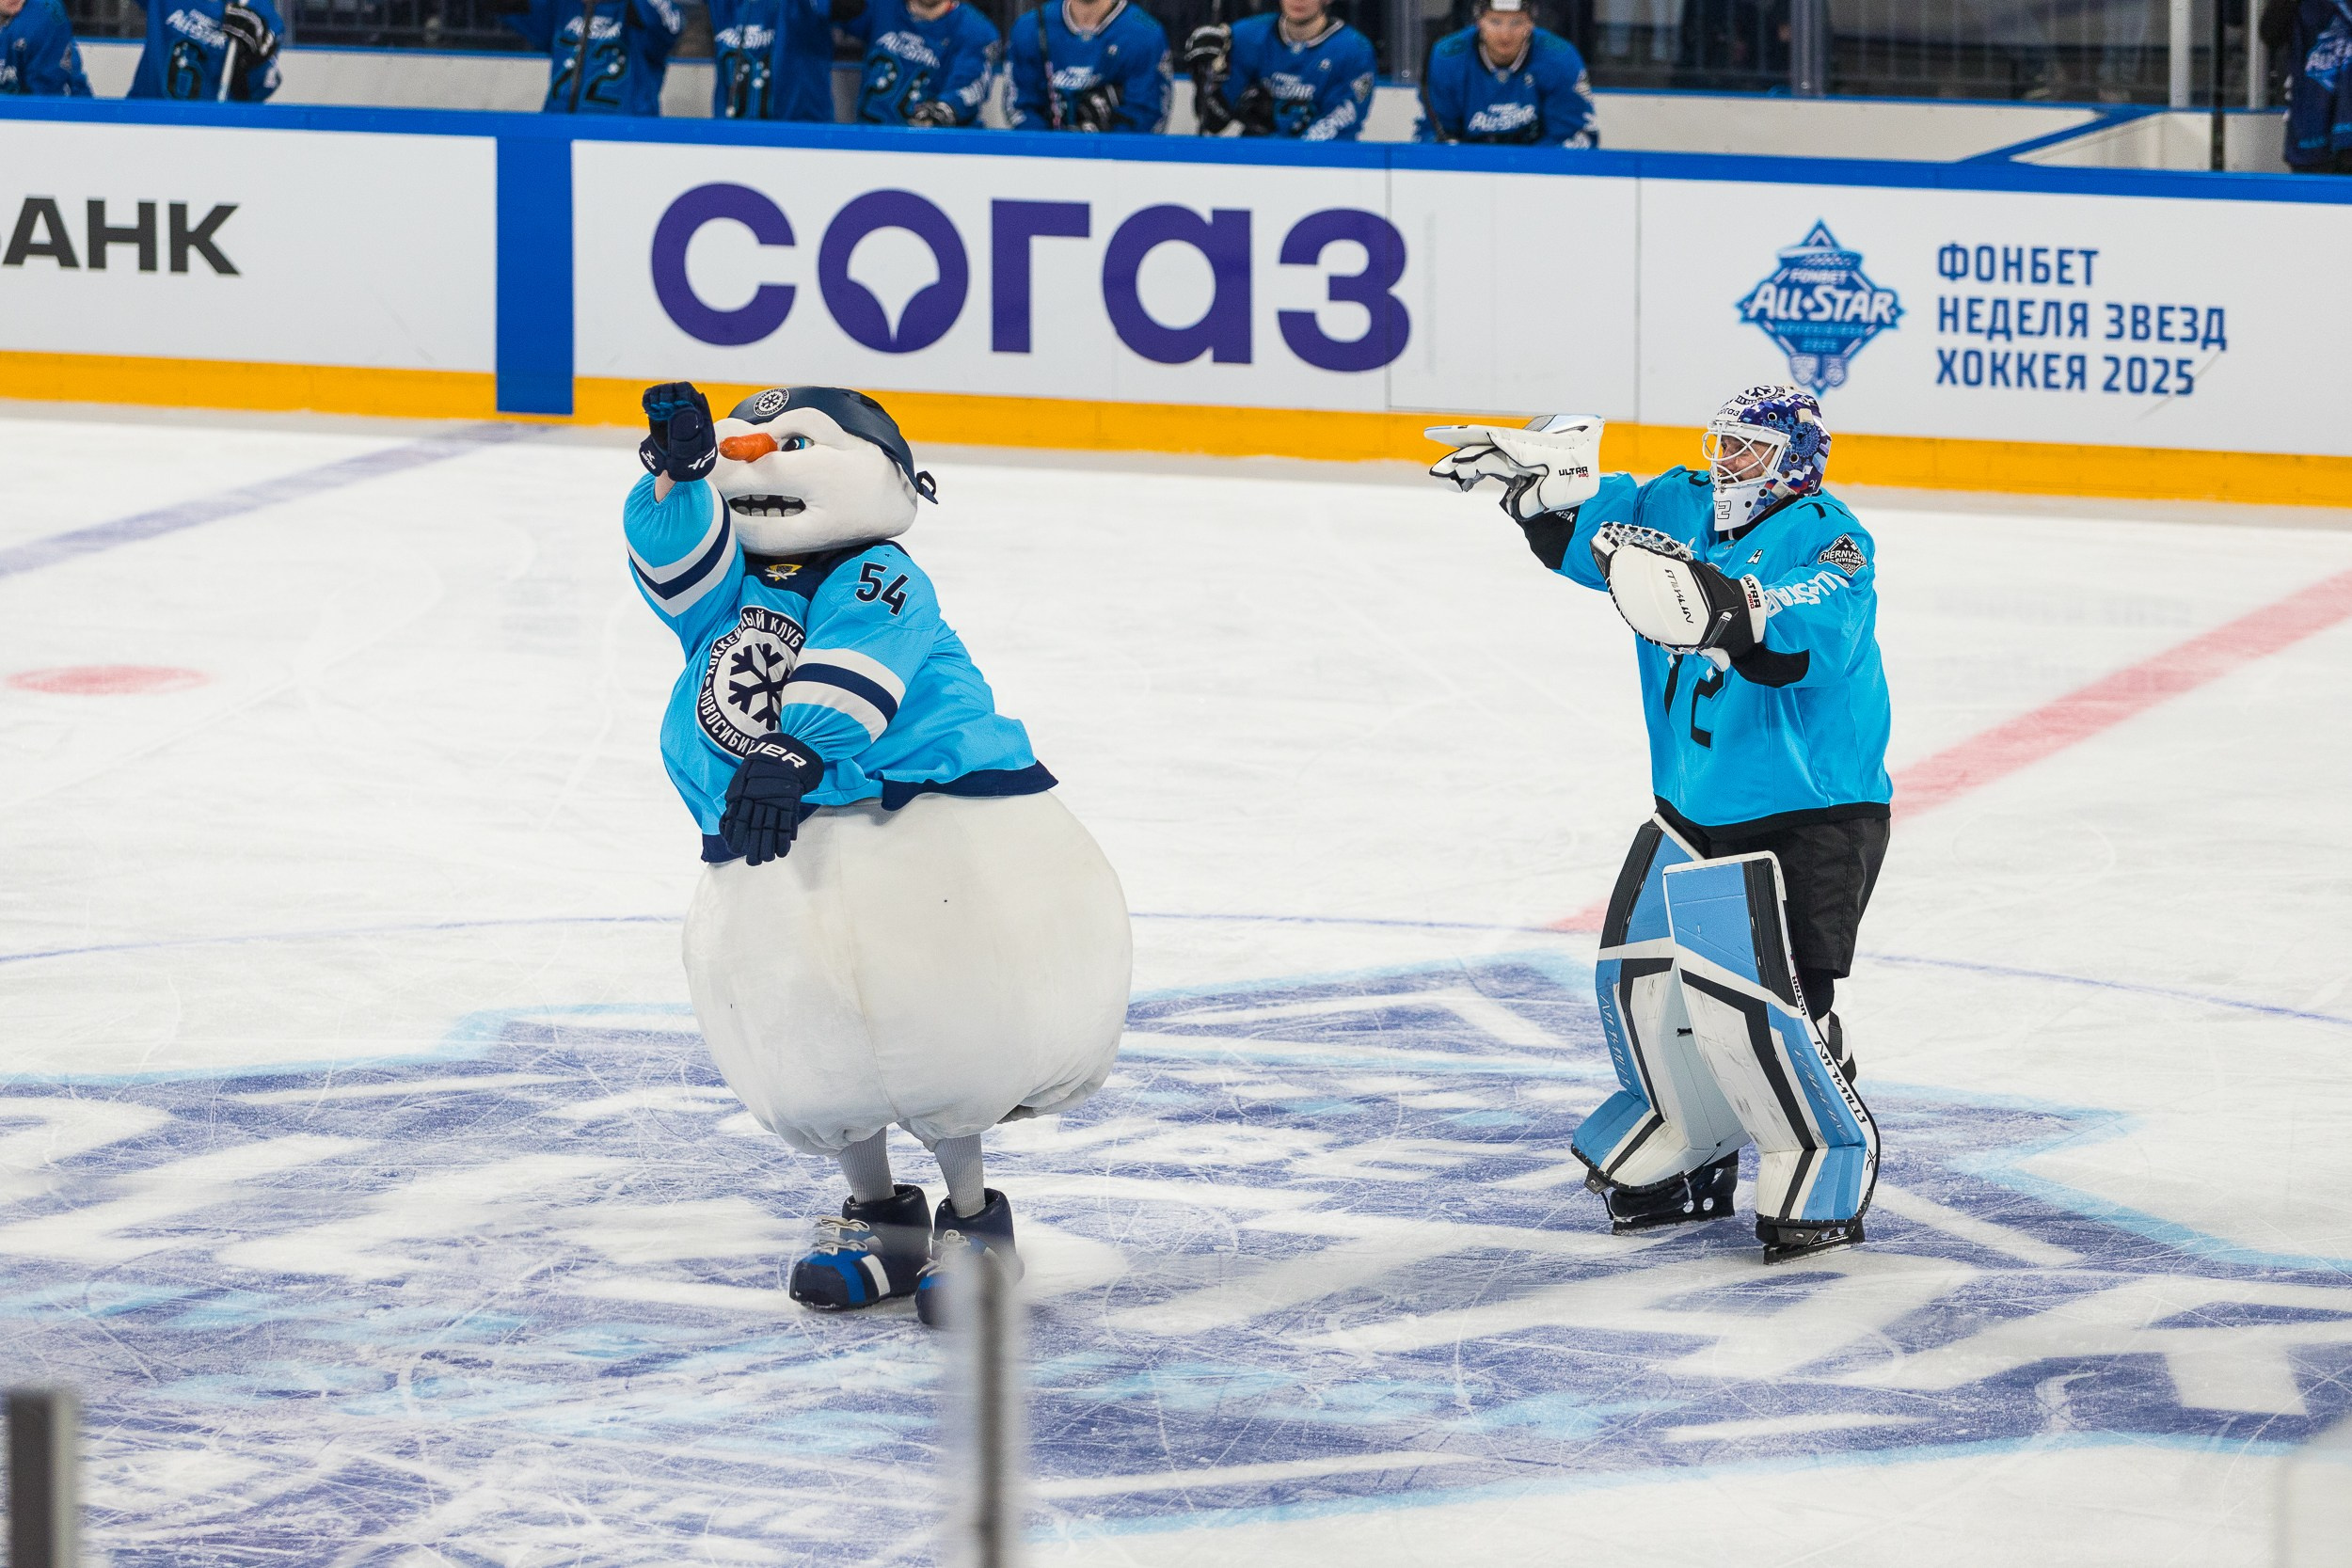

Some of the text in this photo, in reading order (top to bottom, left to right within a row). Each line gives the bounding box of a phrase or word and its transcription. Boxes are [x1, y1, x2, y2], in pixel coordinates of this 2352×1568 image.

[0, 195, 241, 276] АНК
[1937, 242, 2099, 286] ФОНБЕТ
[1938, 295, 2228, 351] НЕДЕЛЯ ЗВЕЗД
[1936, 348, 2195, 395] ХОККЕЯ 2025
[1558, 467, 1588, 476] ULTRA
[855, 562, 909, 616] 54
[1743, 575, 1761, 609] ULTRA
[1747, 594, 1756, 610] PRO
[770, 616, 804, 648] КЛУБ
[1792, 975, 1807, 1016] ULTRA
